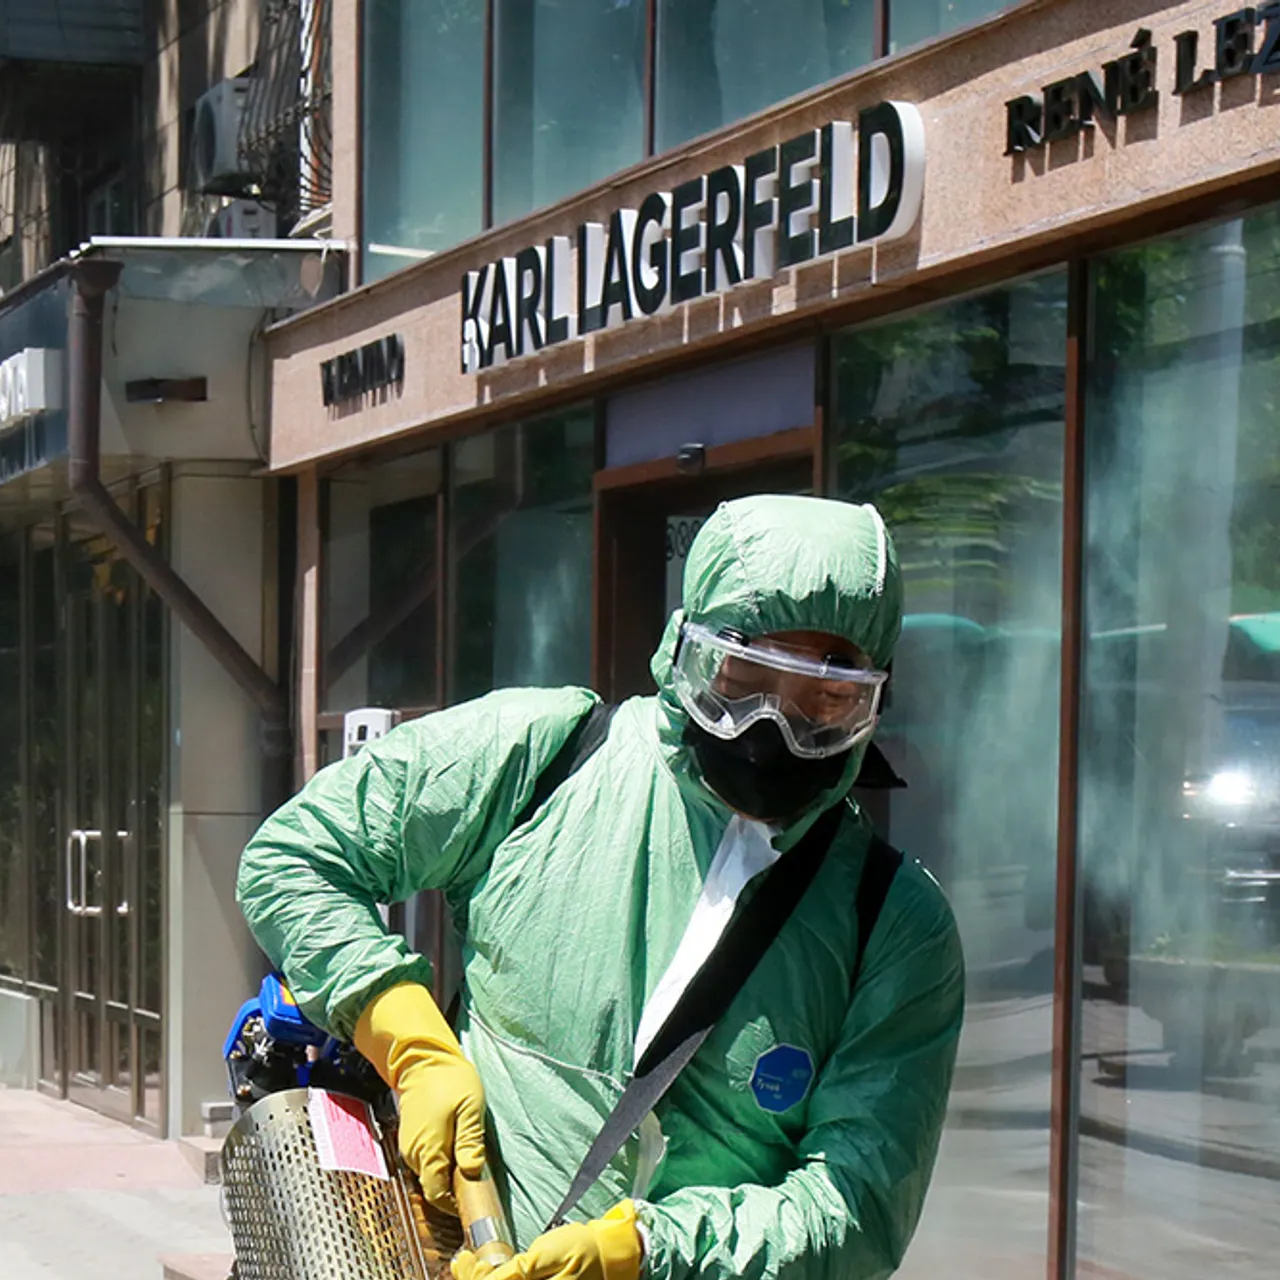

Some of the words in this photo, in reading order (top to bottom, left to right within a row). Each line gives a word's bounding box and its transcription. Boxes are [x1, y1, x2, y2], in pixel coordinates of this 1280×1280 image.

[1004, 28, 1159, 156] RENÉ
[461, 235, 573, 374] KARL
[578, 100, 920, 334] LAGERFELD
